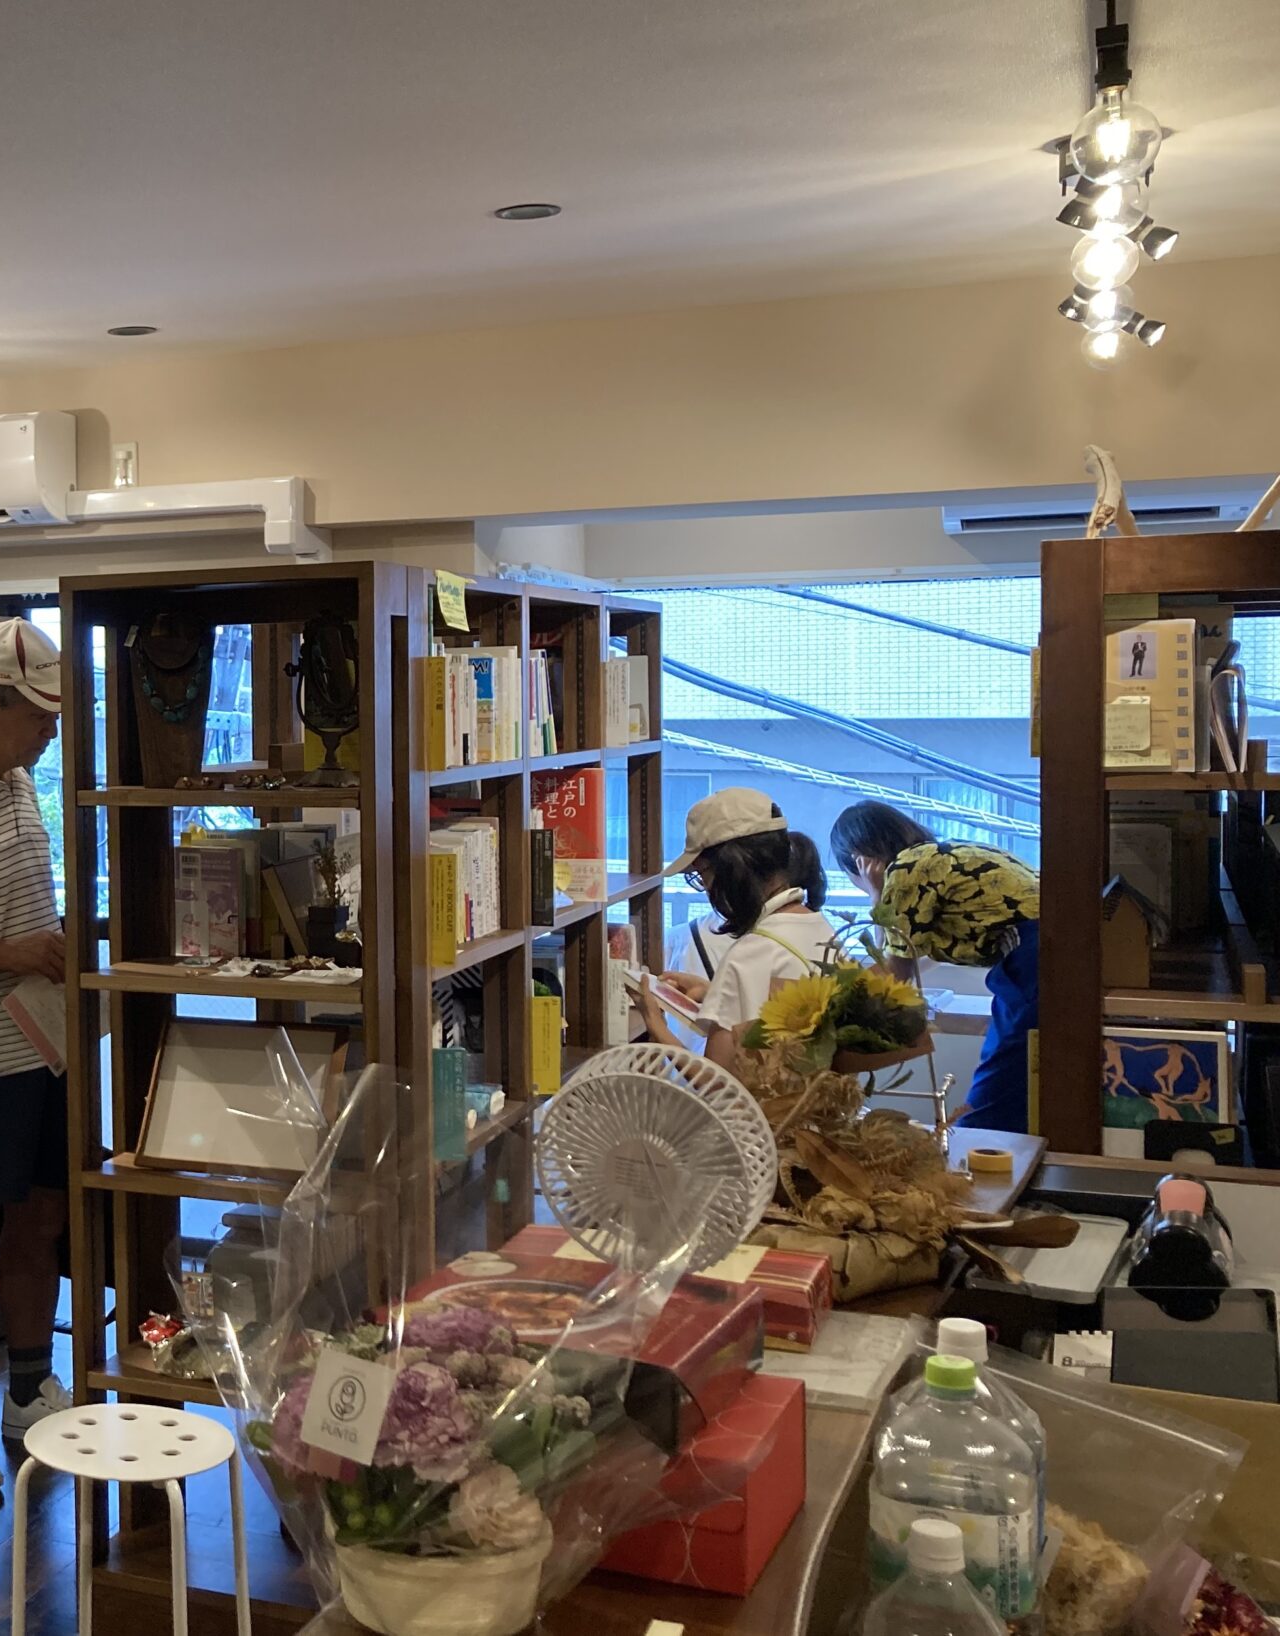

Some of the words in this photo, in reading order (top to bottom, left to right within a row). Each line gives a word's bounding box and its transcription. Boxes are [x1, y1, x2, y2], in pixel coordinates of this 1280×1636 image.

[544, 777, 560, 819] 料理と
[562, 778, 578, 818] 江戸の
[321, 1420, 359, 1443] PUNTO
